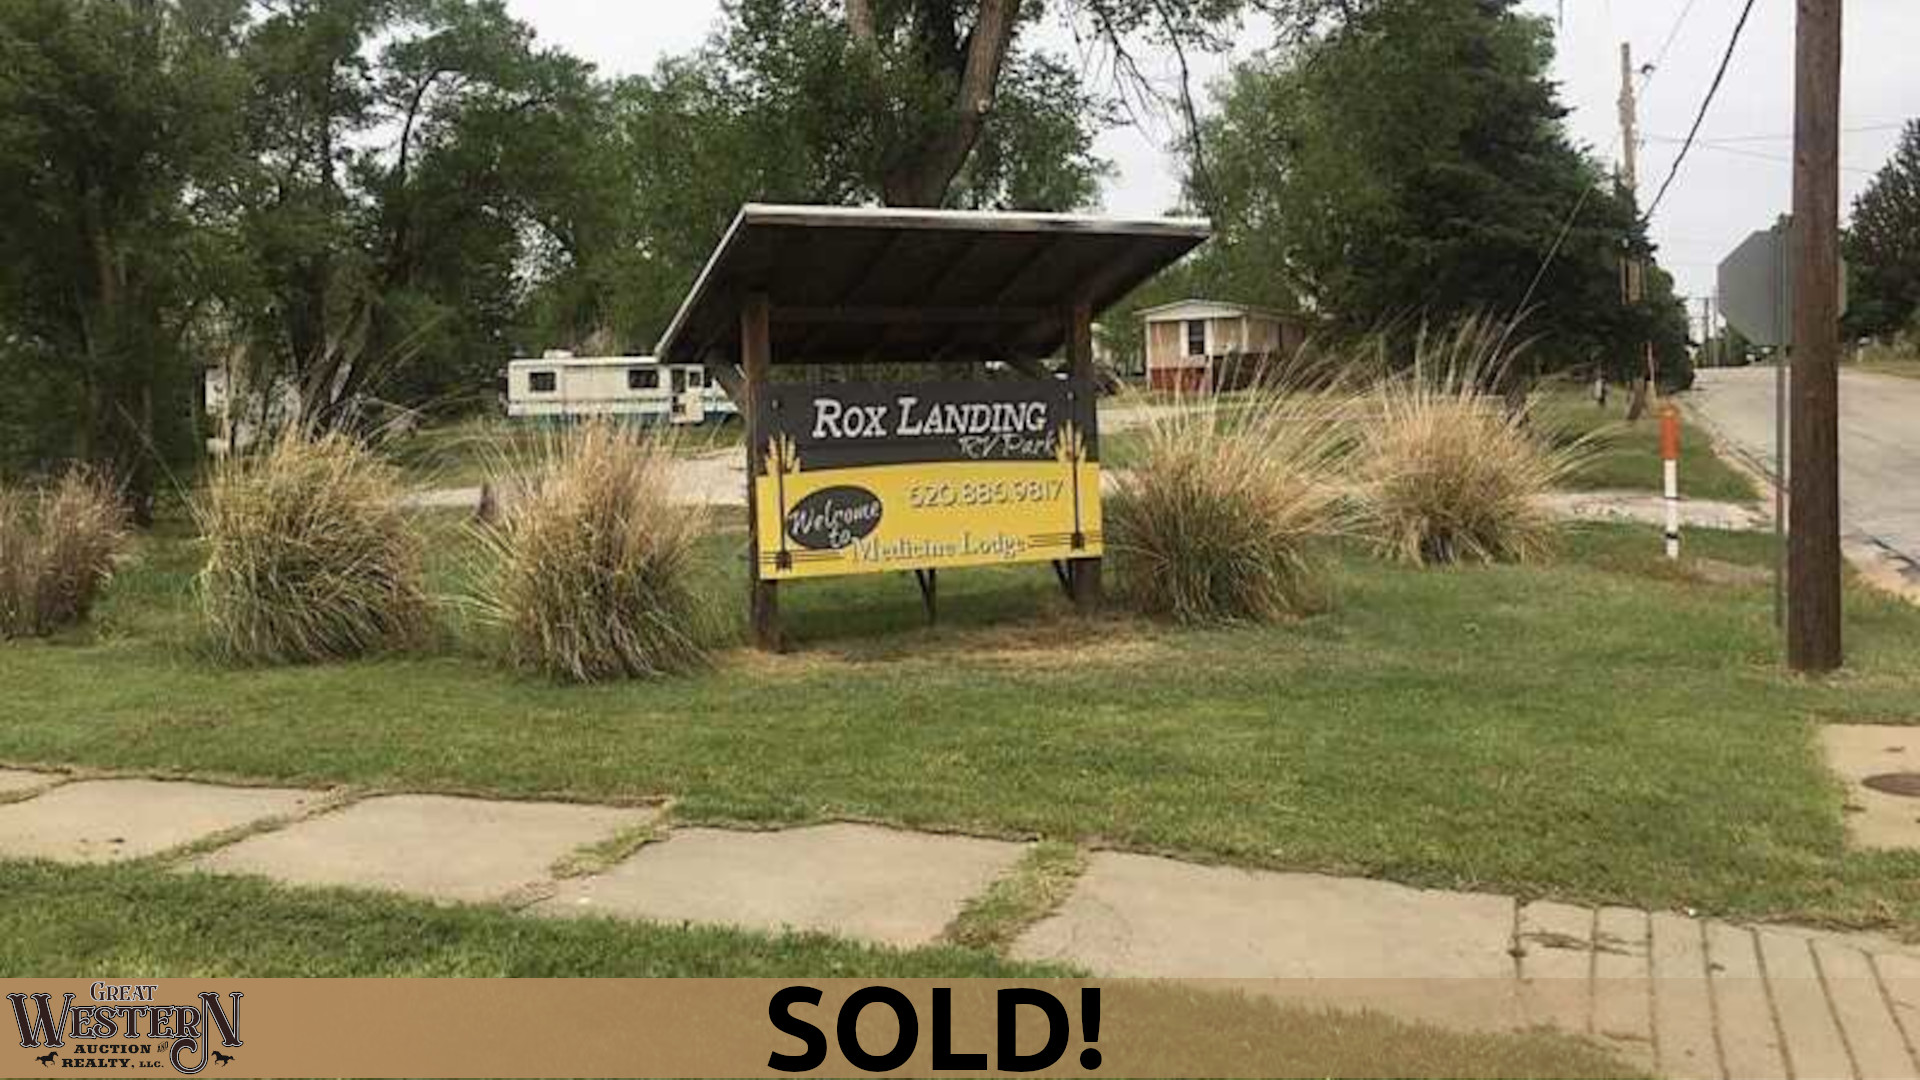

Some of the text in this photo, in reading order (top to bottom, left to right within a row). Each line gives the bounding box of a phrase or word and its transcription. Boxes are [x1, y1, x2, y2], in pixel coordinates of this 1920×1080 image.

[896, 397, 1048, 436] LANDING
[959, 434, 1001, 459] RV
[788, 498, 881, 535] Welcome
[829, 528, 852, 549] to
[849, 530, 1027, 564] Medicine Lodge
